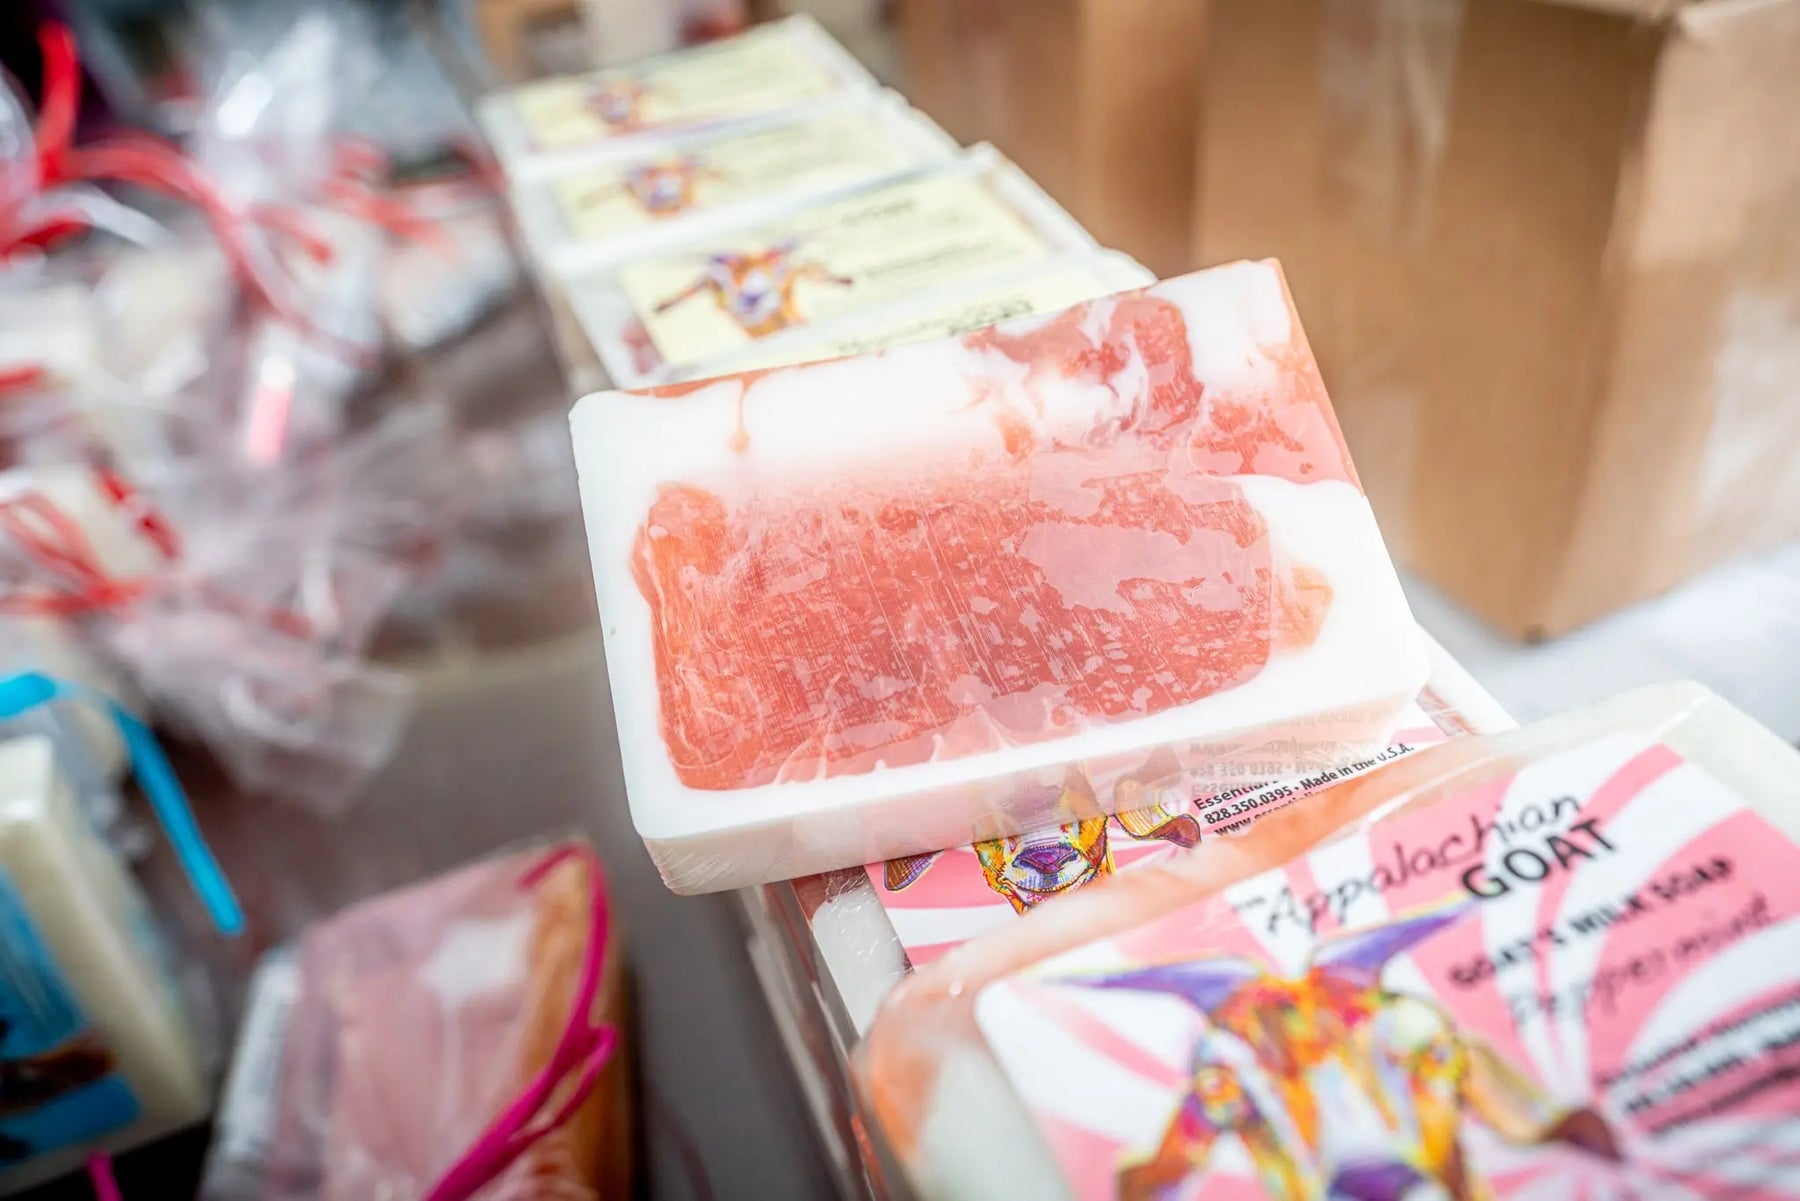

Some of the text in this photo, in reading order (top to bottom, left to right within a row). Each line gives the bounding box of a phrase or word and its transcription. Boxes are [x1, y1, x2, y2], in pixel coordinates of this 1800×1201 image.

[1203, 785, 1293, 825] 828.350.0395
[1299, 771, 1339, 791] Made
[1336, 765, 1354, 777] in
[1266, 793, 1581, 936] Appalachian
[1459, 816, 1616, 900] GOAT
[1567, 894, 1650, 936] MILK
